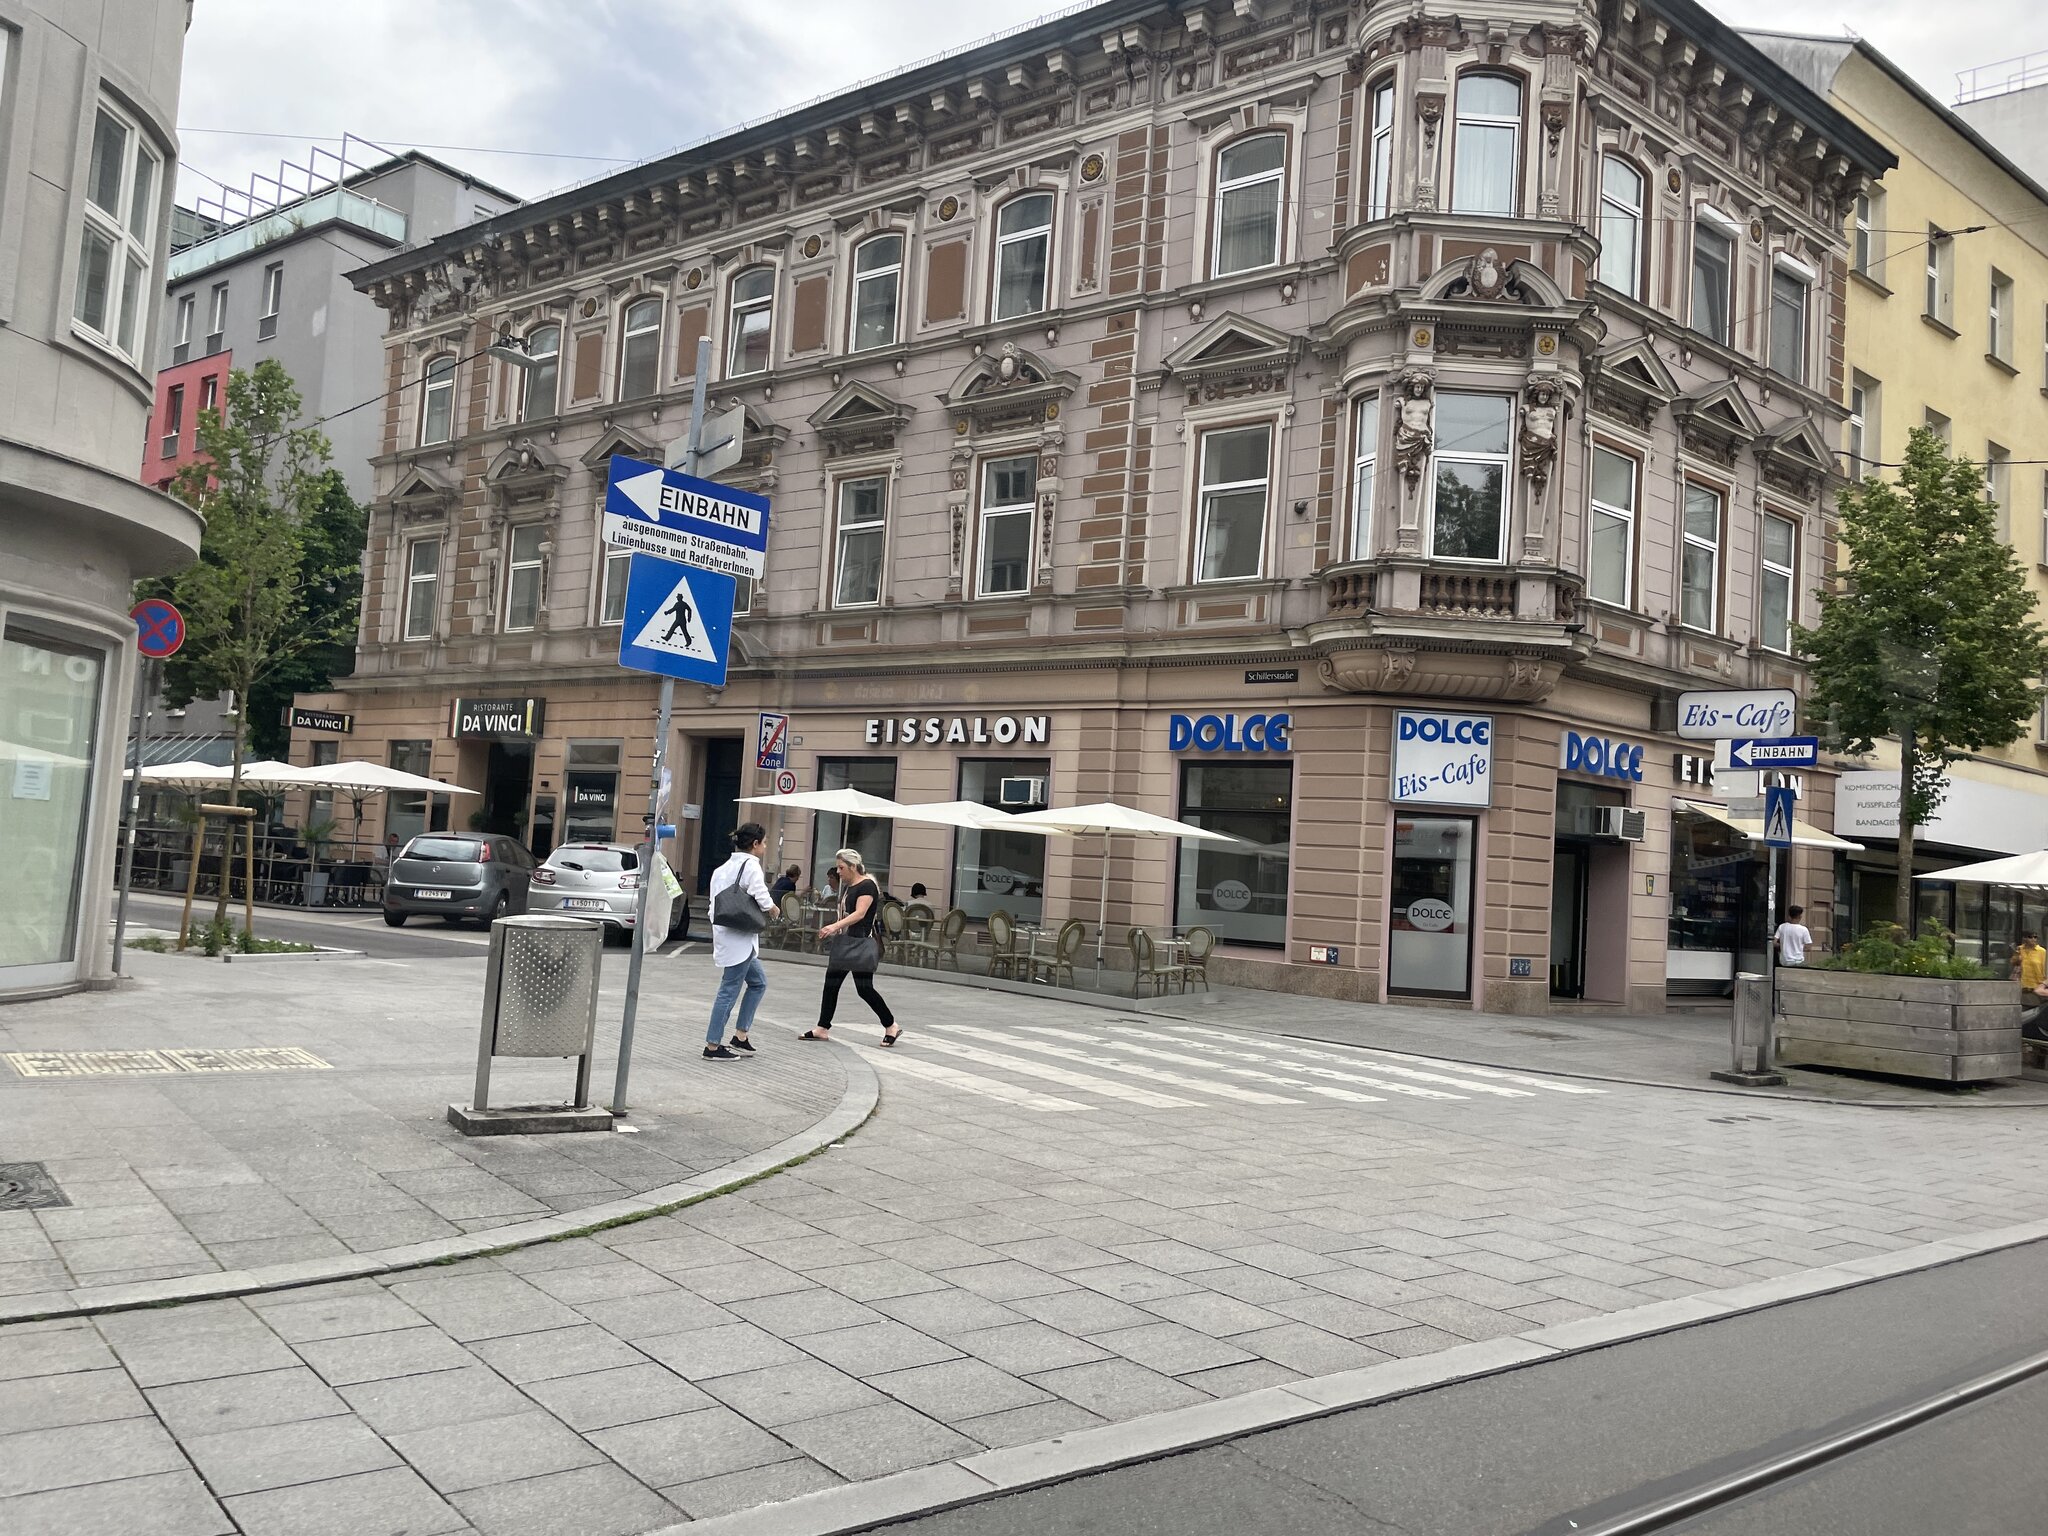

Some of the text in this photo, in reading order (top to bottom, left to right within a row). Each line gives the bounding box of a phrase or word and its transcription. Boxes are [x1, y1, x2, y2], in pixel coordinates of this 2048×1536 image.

[660, 486, 750, 529] EINBAHN
[622, 520, 688, 545] ausgenommen
[612, 531, 755, 576] Linienbusse und RadfahrerInnen
[1248, 671, 1294, 681] Schillerstraße
[473, 703, 513, 712] RISTORANTE
[297, 716, 342, 730] DA VINCI
[462, 714, 522, 732] DA VINCI
[1683, 701, 1790, 734] Eis-Cafe
[865, 716, 1050, 744] EISSALON
[1169, 713, 1293, 752] DOLCE
[1400, 716, 1489, 745] DOLCE
[773, 741, 783, 753] 20
[1751, 746, 1805, 758] EINBAHN
[760, 755, 781, 767] Zone
[1567, 731, 1644, 782] DOLCE
[1398, 753, 1487, 798] Eis-Cafe
[781, 777, 792, 790] 30
[1845, 783, 1902, 791] KOMFORTSCHU
[579, 792, 607, 802] DA VINCI
[985, 873, 1012, 884] DOLCE
[1216, 888, 1249, 900] DOLCE
[1412, 907, 1451, 919] DOLCE
